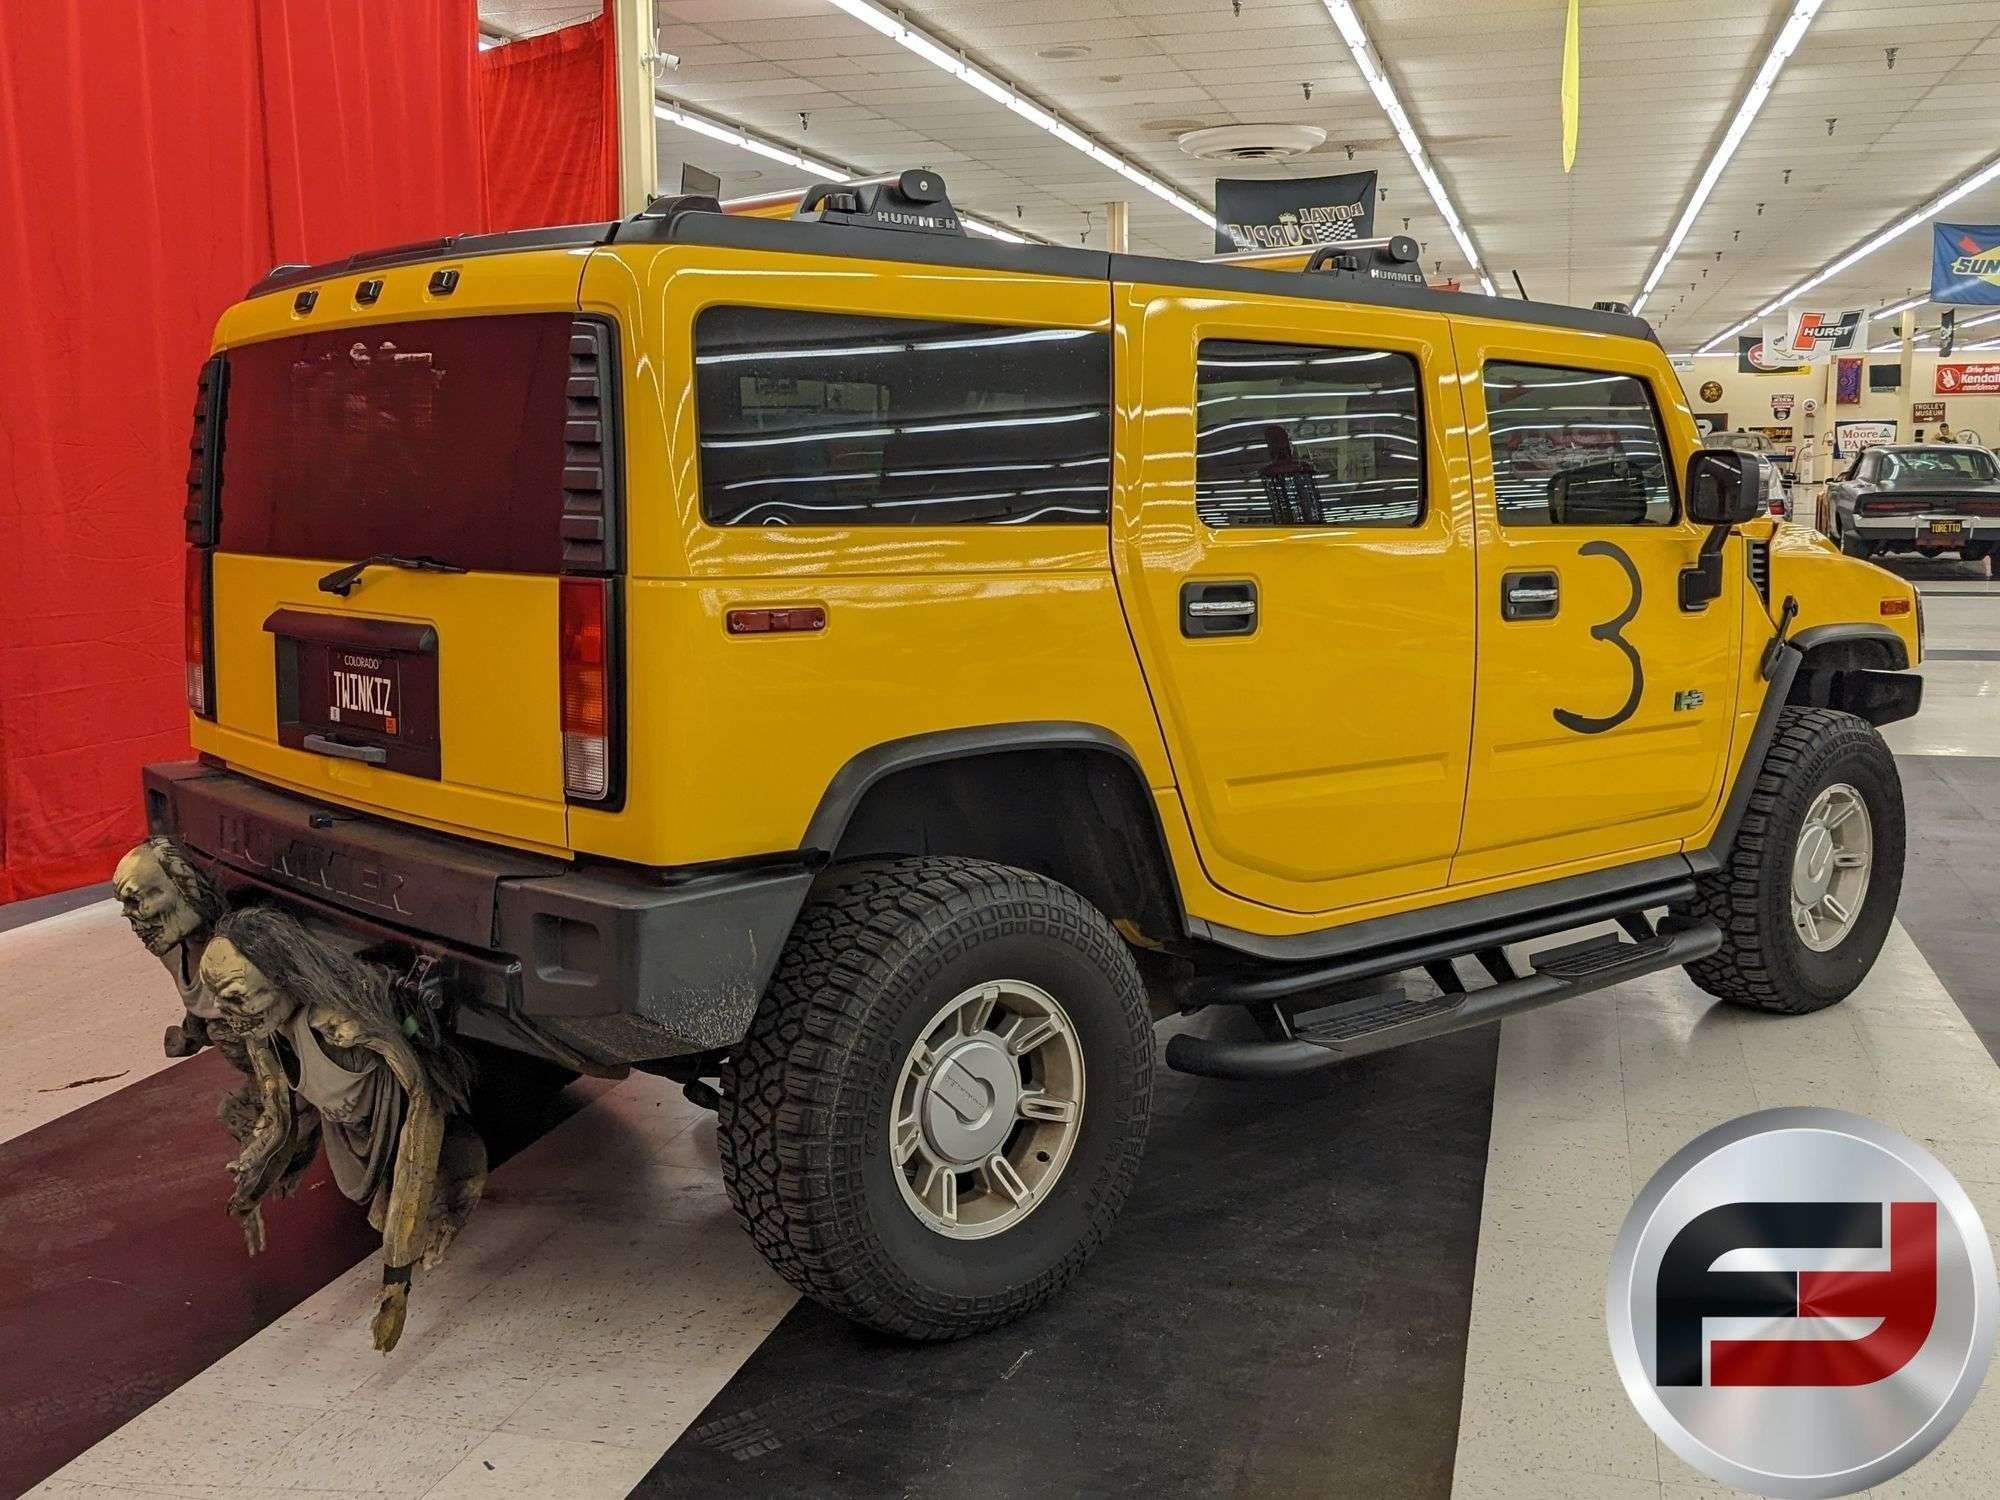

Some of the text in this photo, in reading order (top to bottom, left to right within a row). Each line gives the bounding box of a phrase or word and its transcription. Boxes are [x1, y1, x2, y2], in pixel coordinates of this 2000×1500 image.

[877, 211, 957, 230] HUMMER
[1370, 269, 1423, 283] HUMMER
[1803, 325, 1853, 337] HURST
[1842, 429, 1878, 439] Moore
[1932, 523, 1961, 533] TORETTO
[1552, 540, 1644, 735] 3
[344, 654, 380, 670] COLORADO
[333, 670, 393, 717] TWINKIZ
